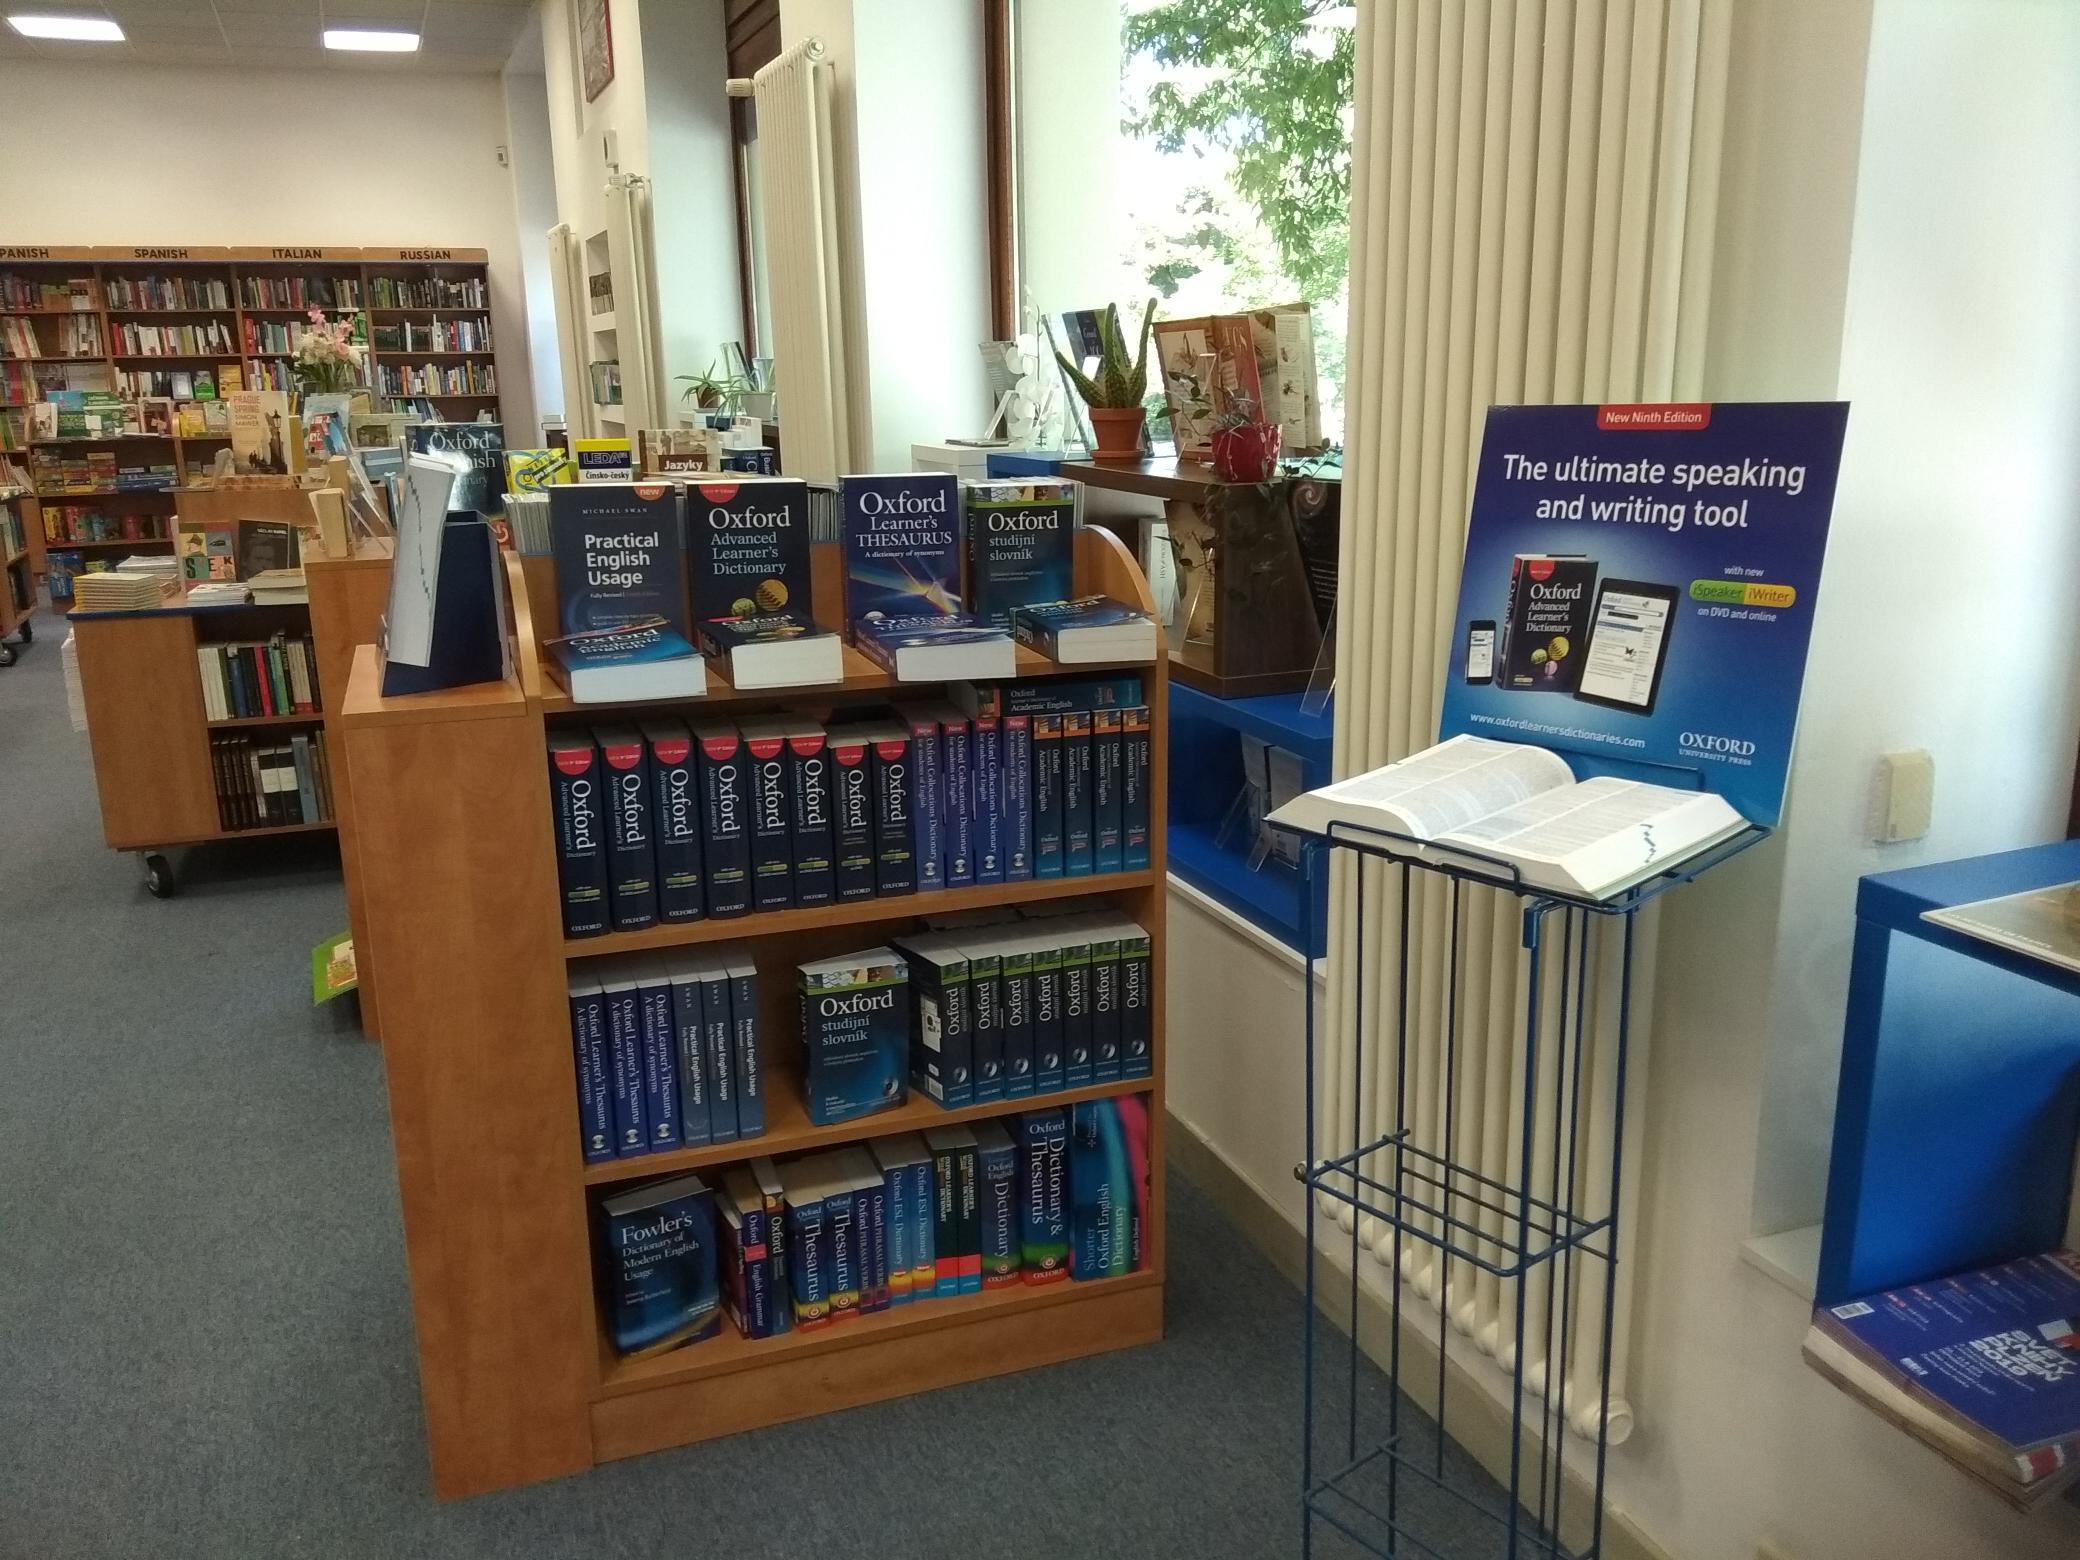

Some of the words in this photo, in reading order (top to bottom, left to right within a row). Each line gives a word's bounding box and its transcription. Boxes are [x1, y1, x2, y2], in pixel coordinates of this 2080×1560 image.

[0, 248, 49, 259] PANISH
[135, 249, 188, 259] SPANISH
[272, 249, 322, 259] ITALIAN
[400, 250, 451, 260] RUSSIAN
[1606, 412, 1630, 423] New
[1632, 412, 1662, 423] Ninth
[1664, 412, 1702, 423] Edition
[430, 431, 490, 450] Oxford
[583, 453, 621, 464] LEDA
[664, 460, 703, 471] Jazyky
[586, 471, 629, 480] Čínsko-český
[1503, 454, 1548, 481] The
[1554, 456, 1665, 484] ultimate
[1672, 458, 1806, 495] speaking
[860, 489, 947, 515] Oxford
[1536, 495, 1585, 521] and
[1590, 496, 1686, 532] writing
[1694, 499, 1748, 528] tool
[709, 506, 792, 529] Oxford
[870, 515, 938, 531] Learner's
[988, 510, 1059, 531] Oxford
[584, 532, 659, 549] Practical
[711, 531, 777, 545] Advanced
[856, 531, 952, 547] THESAURUS
[989, 534, 1035, 547] studijní
[586, 551, 650, 570] English
[713, 547, 779, 560] Learner's
[990, 549, 1033, 561] slovník
[588, 571, 643, 588] Usage
[713, 561, 786, 575] Dictionary
[1724, 566, 1743, 576] with
[1745, 568, 1764, 577] new
[1530, 583, 1581, 600] Oxford
[1694, 584, 1743, 598] iSpeaker
[1749, 588, 1790, 602] iWriter
[1528, 602, 1570, 611] Advanced
[1528, 612, 1569, 621] Learner's
[1697, 608, 1709, 616] on
[1710, 608, 1729, 618] DVD
[1730, 609, 1747, 620] and
[1749, 612, 1777, 623] online
[569, 629, 660, 646] Oxford
[1526, 623, 1572, 633] Dictionary
[578, 637, 661, 651] Academic
[580, 644, 646, 654] English
[1011, 689, 1036, 698] Oxford
[1011, 702, 1046, 711] Academic
[1047, 701, 1072, 709] English
[1470, 712, 1646, 749] www.oxfordlearnersdictionaries.com
[1679, 731, 1756, 756] OXFORD
[957, 735, 965, 763] Oxford
[1018, 731, 1026, 758] Oxford
[1679, 748, 1727, 762] UNIVERSITY
[1729, 756, 1752, 766] PRESS
[764, 762, 786, 828] Oxford
[805, 759, 826, 825] Oxford
[889, 764, 907, 822] Oxford
[958, 765, 967, 814] Collocations
[1018, 760, 1026, 809] Collocations
[622, 774, 645, 843] Oxford
[670, 769, 693, 837] Oxford
[719, 765, 740, 832] Oxford
[848, 770, 867, 827] Oxford
[572, 780, 596, 850] Oxford
[960, 817, 968, 857] Dictionary
[1039, 974, 1052, 1022] Oxford
[1068, 970, 1081, 1017] Oxford
[1126, 962, 1139, 1008] Oxford
[623, 999, 635, 1033] Oxford
[655, 994, 667, 1028] Oxford
[820, 989, 894, 1017] Oxford
[947, 987, 960, 1036] Oxford
[977, 982, 990, 1030] Oxford
[716, 1022, 726, 1051] Practical
[822, 1015, 870, 1032] studijní
[659, 1029, 670, 1073] Learner's
[823, 1030, 868, 1046] slovník
[626, 1036, 639, 1078] Learner's
[717, 1052, 726, 1079] English
[747, 1048, 755, 1074] English
[661, 1073, 671, 1119] Thesaurus
[719, 1080, 727, 1101] Usage
[748, 1076, 756, 1096] Usage
[629, 1079, 640, 1124] Thesaurus
[1029, 1120, 1065, 1135] Oxford
[987, 1161, 1014, 1172] Oxford
[1045, 1136, 1065, 1223] Dictionary
[918, 1166, 927, 1196] Oxford
[1032, 1137, 1048, 1224] Thesaurus
[797, 1207, 822, 1218] Oxford
[827, 1197, 851, 1209] Oxford
[874, 1195, 883, 1226] Oxford
[1098, 1183, 1110, 1225] English
[622, 1211, 693, 1245] Fowler's
[749, 1214, 759, 1244] Oxford
[994, 1182, 1009, 1259] Dictionary
[1050, 1225, 1063, 1236] &
[622, 1237, 672, 1257] Dictionary
[674, 1231, 685, 1242] of
[771, 1216, 783, 1254] Oxford
[875, 1227, 883, 1262] PHRASAL
[920, 1217, 928, 1259] Dictionary
[1097, 1227, 1109, 1269] Oxford
[1112, 1206, 1127, 1266] Dictionary
[624, 1249, 662, 1269] Modern
[665, 1240, 699, 1257] English
[804, 1218, 822, 1302] Thesaurus
[834, 1208, 851, 1291] Thesaurus
[1085, 1228, 1096, 1271] Shorter
[625, 1268, 654, 1281] Usage
[752, 1264, 761, 1292] English
[988, 1272, 1018, 1282] OXFORD
[1033, 1267, 1065, 1280] OXFORD
[754, 1293, 764, 1327] Grammar
[1967, 1341, 2029, 1376] 2019
[1994, 1333, 2074, 1373] KNIHY
